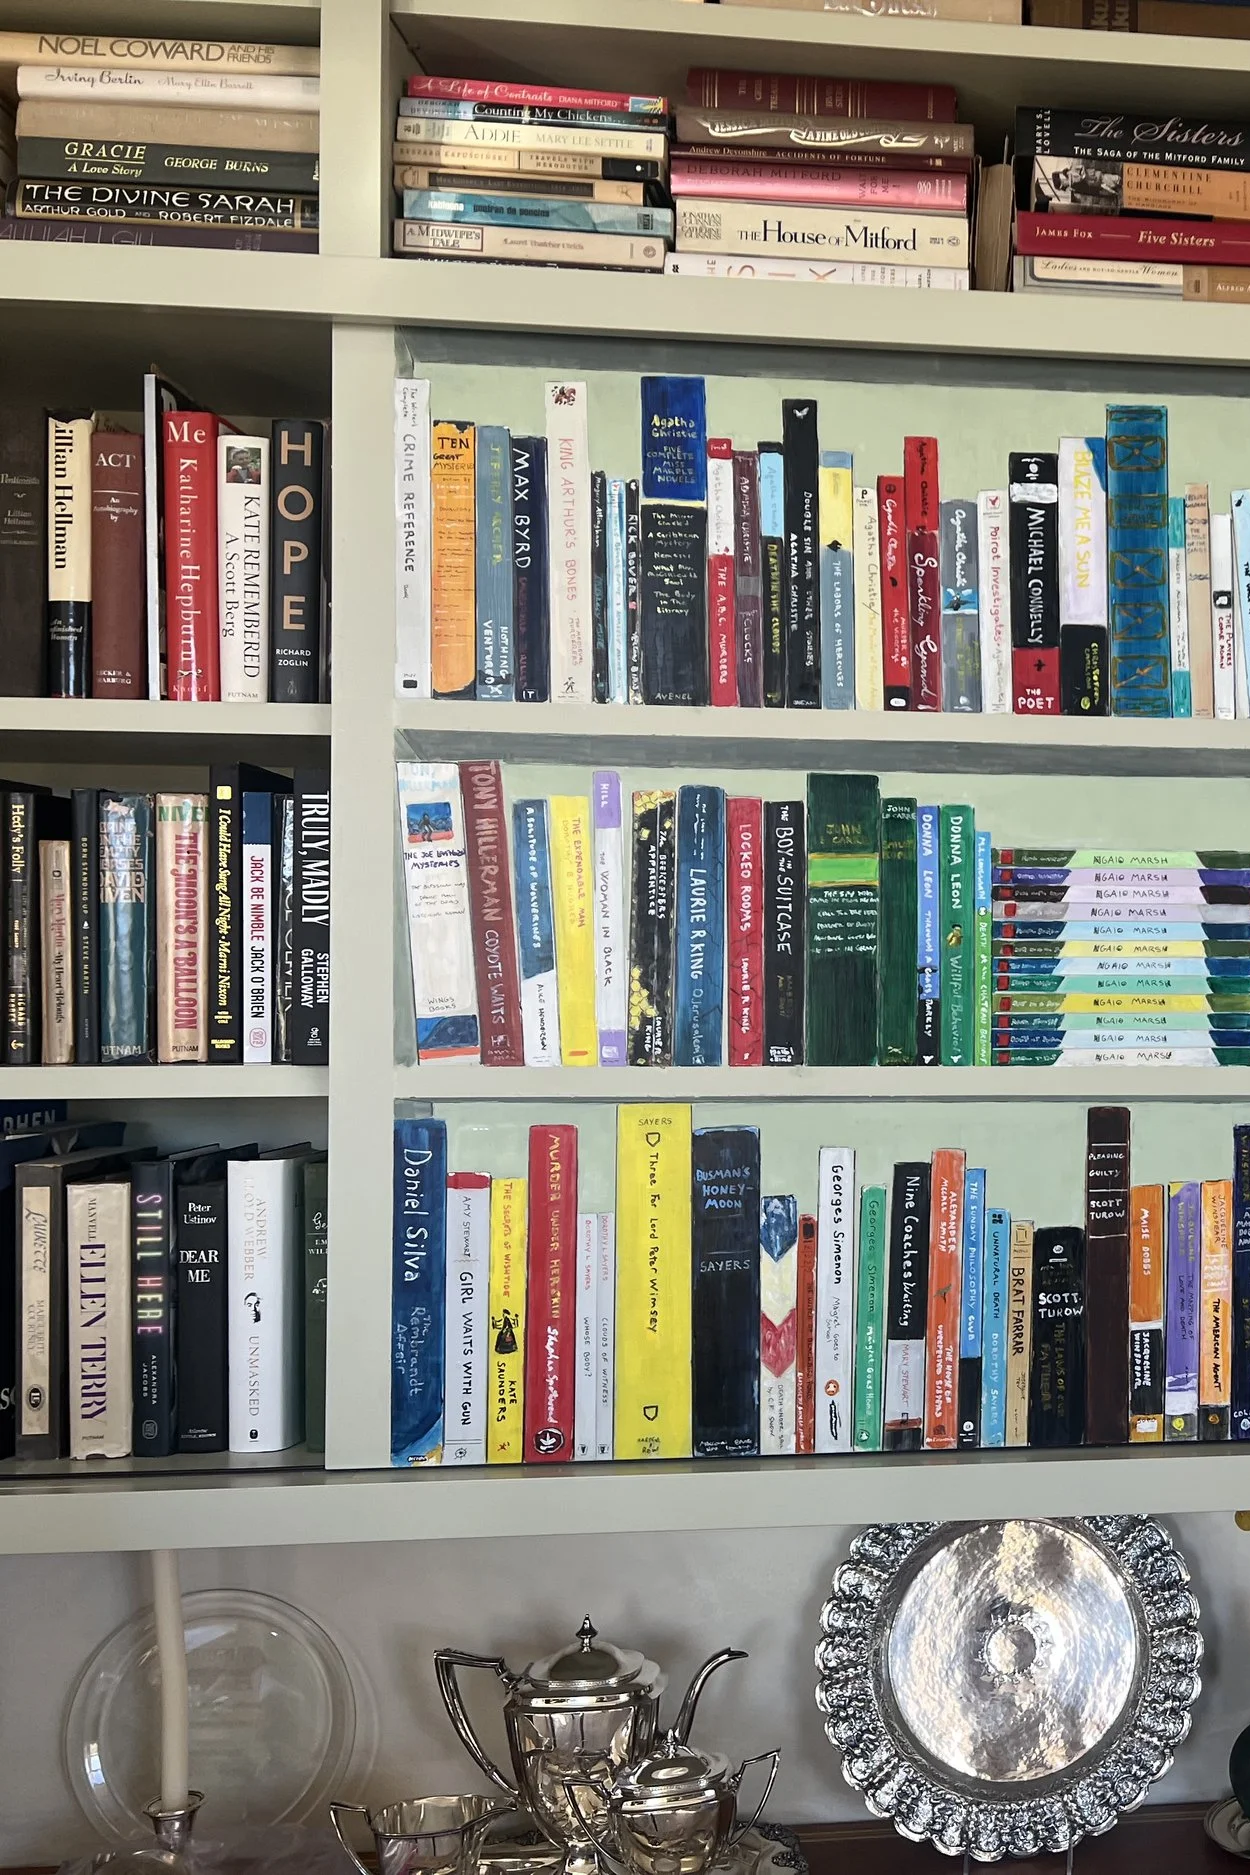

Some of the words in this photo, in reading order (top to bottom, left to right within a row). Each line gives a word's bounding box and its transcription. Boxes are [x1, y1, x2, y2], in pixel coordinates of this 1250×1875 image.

[38, 35, 106, 58] NOEL
[109, 37, 225, 62] COWARD
[45, 68, 96, 88] Irving
[100, 71, 144, 85] Berlin
[474, 102, 530, 120] Counting
[535, 104, 554, 120] My
[1074, 116, 1124, 139] The
[1131, 117, 1244, 146] Sisters
[65, 142, 146, 160] GRACIE
[164, 157, 217, 170] GEORGE
[224, 160, 269, 173] BURNS
[1126, 150, 1138, 158] OF
[1143, 152, 1160, 160] THE
[26, 184, 82, 201] THE
[93, 187, 190, 207] DIVINE
[198, 193, 294, 214] SARAH
[738, 230, 761, 242] THE
[762, 221, 826, 245] House
[828, 235, 844, 247] OF
[845, 225, 917, 251] Mitford
[1138, 231, 1166, 244] Five
[1170, 231, 1216, 247] Sisters
[167, 421, 206, 444] Me
[403, 434, 415, 481] CRIME
[513, 448, 528, 501] MAX
[54, 482, 74, 570] Hellman
[179, 458, 198, 559] Katharine
[244, 496, 260, 544] KATE
[226, 532, 239, 549] A.
[277, 431, 314, 630] HOPE
[404, 492, 415, 571] REFERENCE
[515, 516, 531, 568] BYRD
[1026, 508, 1045, 573] MICHAEL
[225, 553, 240, 594] Scott
[175, 565, 201, 670] Hepburn
[222, 601, 239, 637] Berg
[243, 550, 260, 678] REMEMBERED
[1027, 579, 1043, 643] CONNELLY
[275, 648, 311, 657] RICHARD
[278, 659, 308, 667] ZOGLIN
[1018, 697, 1054, 709] POET
[467, 762, 497, 810] TONY
[298, 792, 330, 856] TRULY,
[951, 816, 962, 866] DONNA
[251, 856, 264, 883] JACK
[473, 818, 502, 921] HILLERMAN
[251, 887, 264, 900] BE
[301, 859, 330, 926] MADLY
[951, 873, 962, 909] LEON
[251, 904, 264, 942] NIMBLE
[776, 876, 793, 955] SUITCASE
[251, 945, 264, 972] JACK
[317, 952, 329, 1004] STEPHEN
[251, 975, 264, 1019] O'BRIEN
[300, 949, 313, 1008] GALLOWAY
[402, 1148, 432, 1216] Daniel
[831, 1164, 844, 1225] Georges
[184, 1214, 217, 1225] Ustinov
[188, 1203, 211, 1212] Peter
[1090, 1199, 1123, 1209] SCOTT
[1090, 1210, 1125, 1220] TUROW
[136, 1194, 163, 1261] STILL
[179, 1250, 219, 1264] DEAR
[403, 1227, 428, 1282] Silva
[701, 1260, 750, 1272] SAYERS
[833, 1232, 845, 1285] Simenon
[80, 1243, 106, 1328] ELLEN
[188, 1269, 210, 1283] ME
[459, 1272, 474, 1304] GIRL
[1011, 1267, 1024, 1303] BRAT
[137, 1276, 163, 1335] HERE
[463, 1312, 473, 1356] WAITS
[1012, 1310, 1025, 1356] FARRAR
[81, 1336, 107, 1426] TERRY
[462, 1363, 472, 1395] WITH
[461, 1401, 472, 1426] GUN
